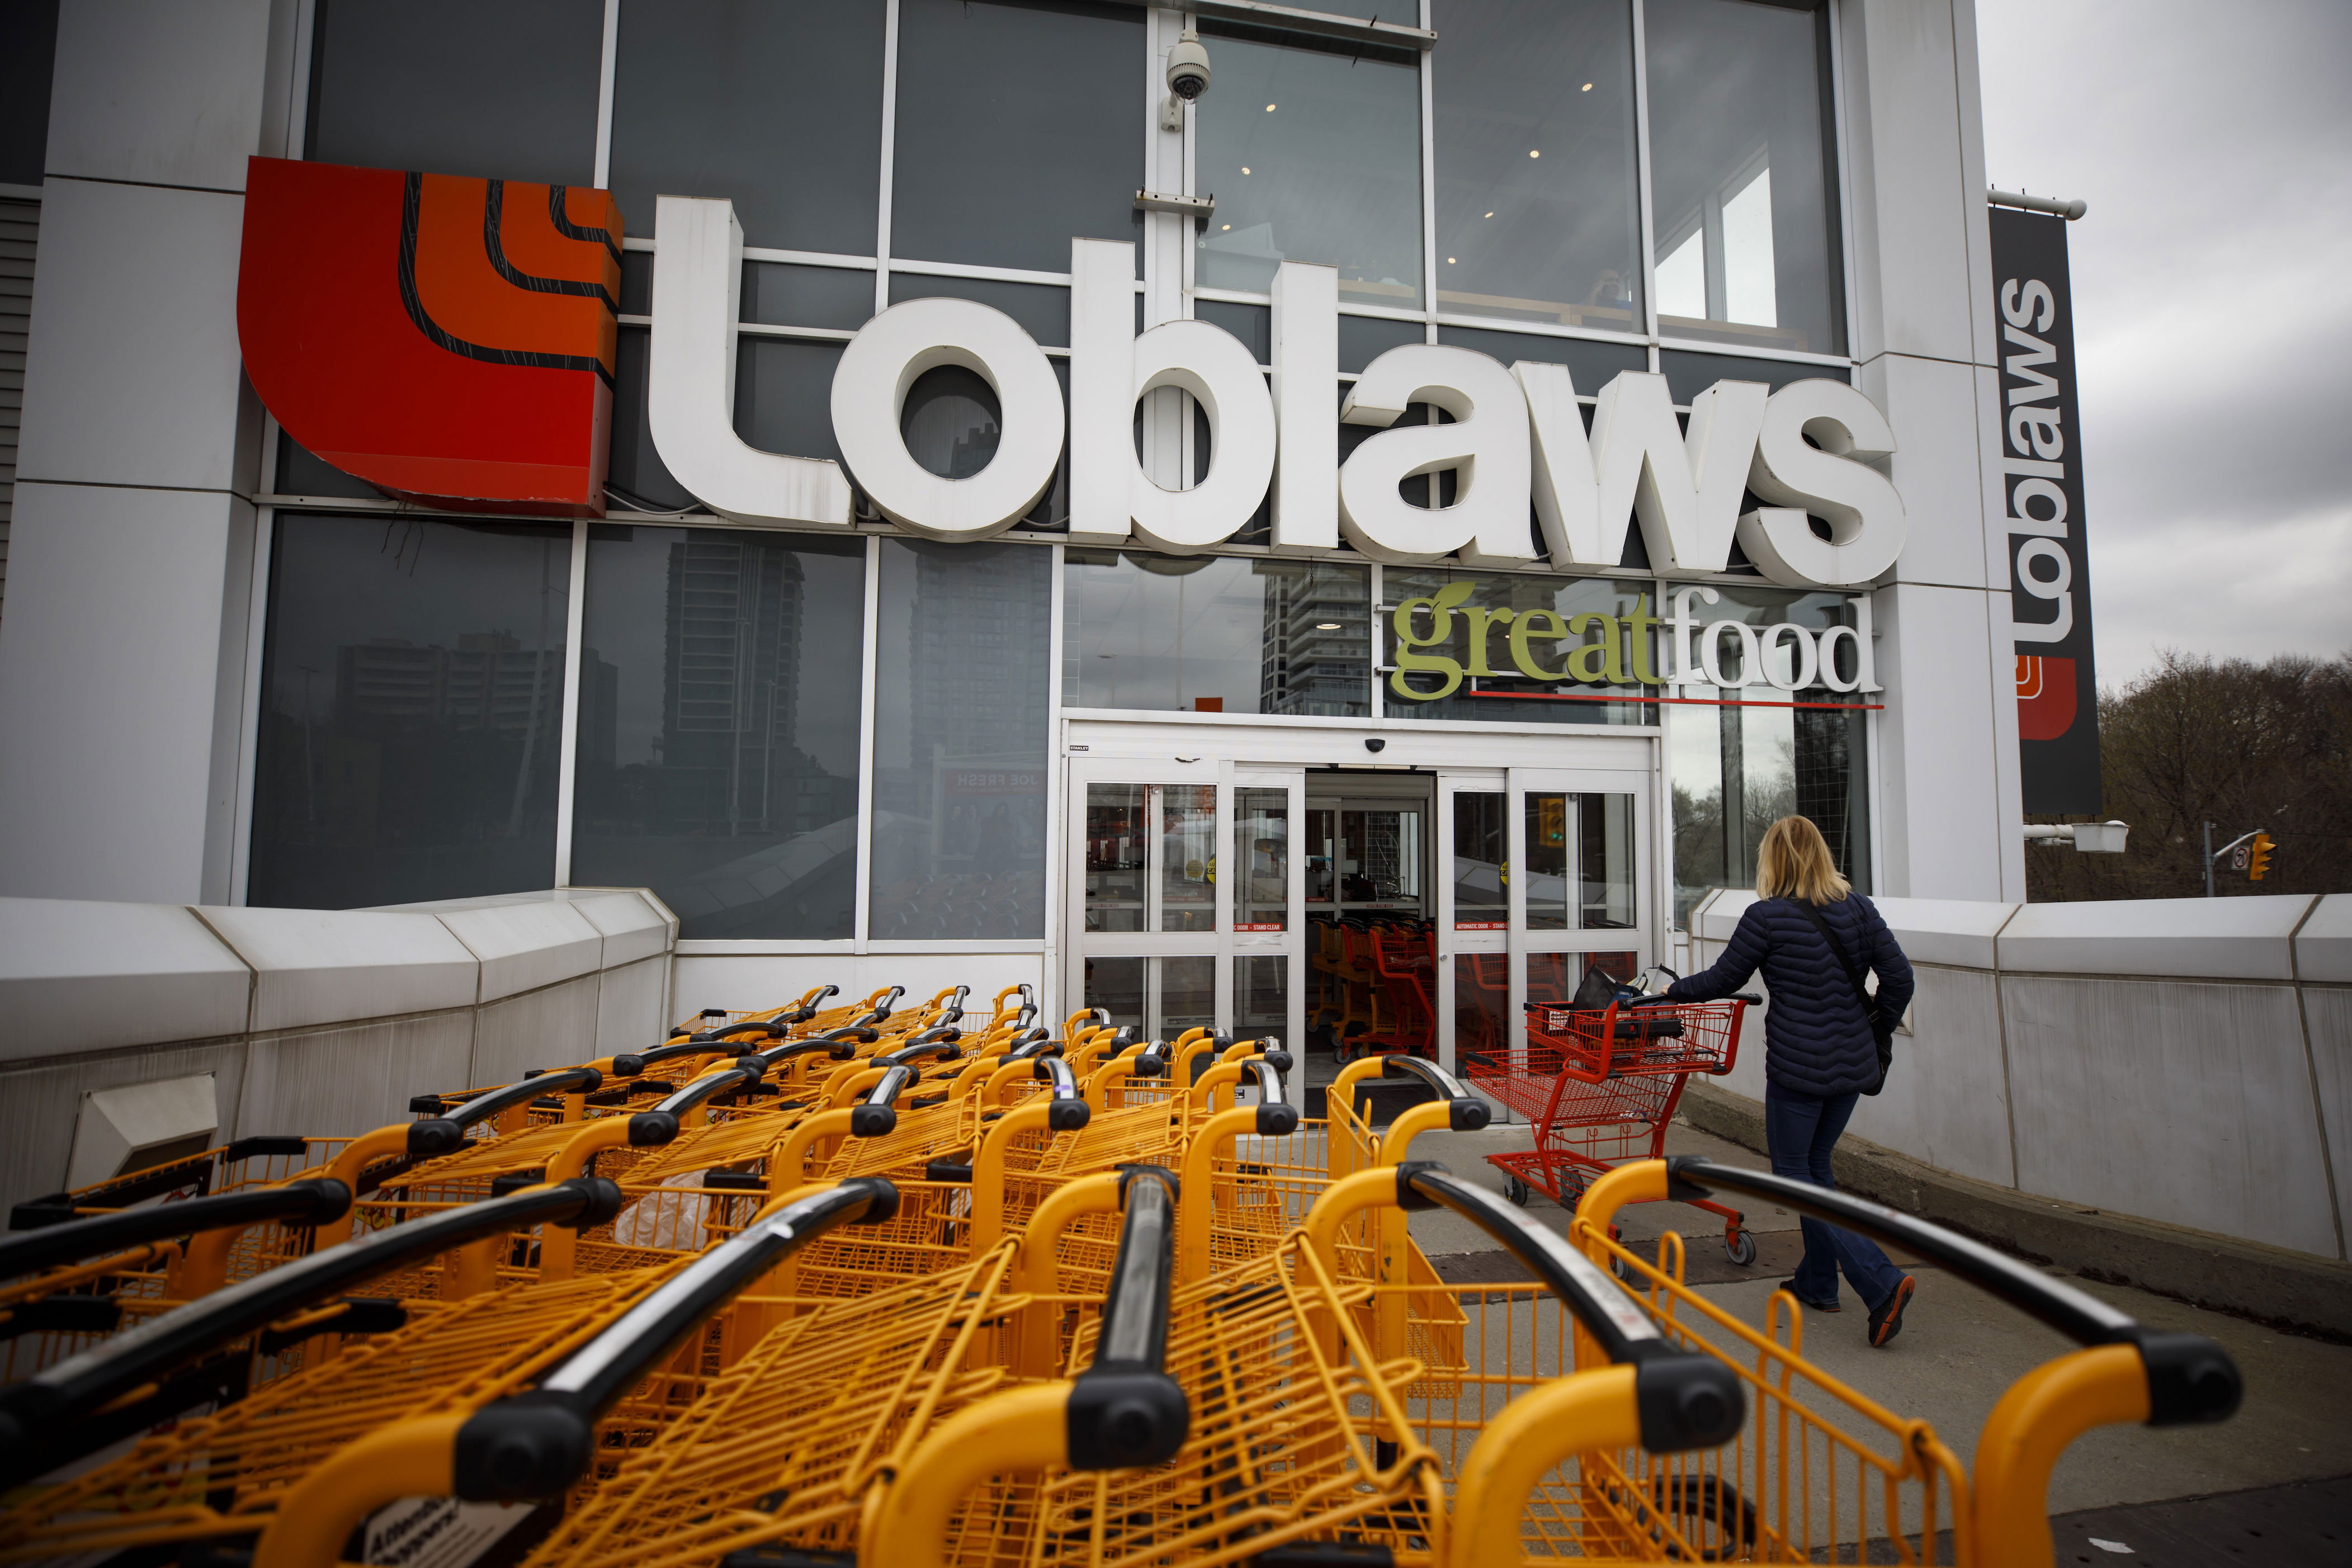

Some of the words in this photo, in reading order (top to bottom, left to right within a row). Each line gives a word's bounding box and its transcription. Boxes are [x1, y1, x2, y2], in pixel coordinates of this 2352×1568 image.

[649, 195, 1906, 586] Loblaws
[2001, 278, 2074, 643] Loblaws
[1390, 582, 1665, 700] great
[1665, 587, 1884, 693] food
